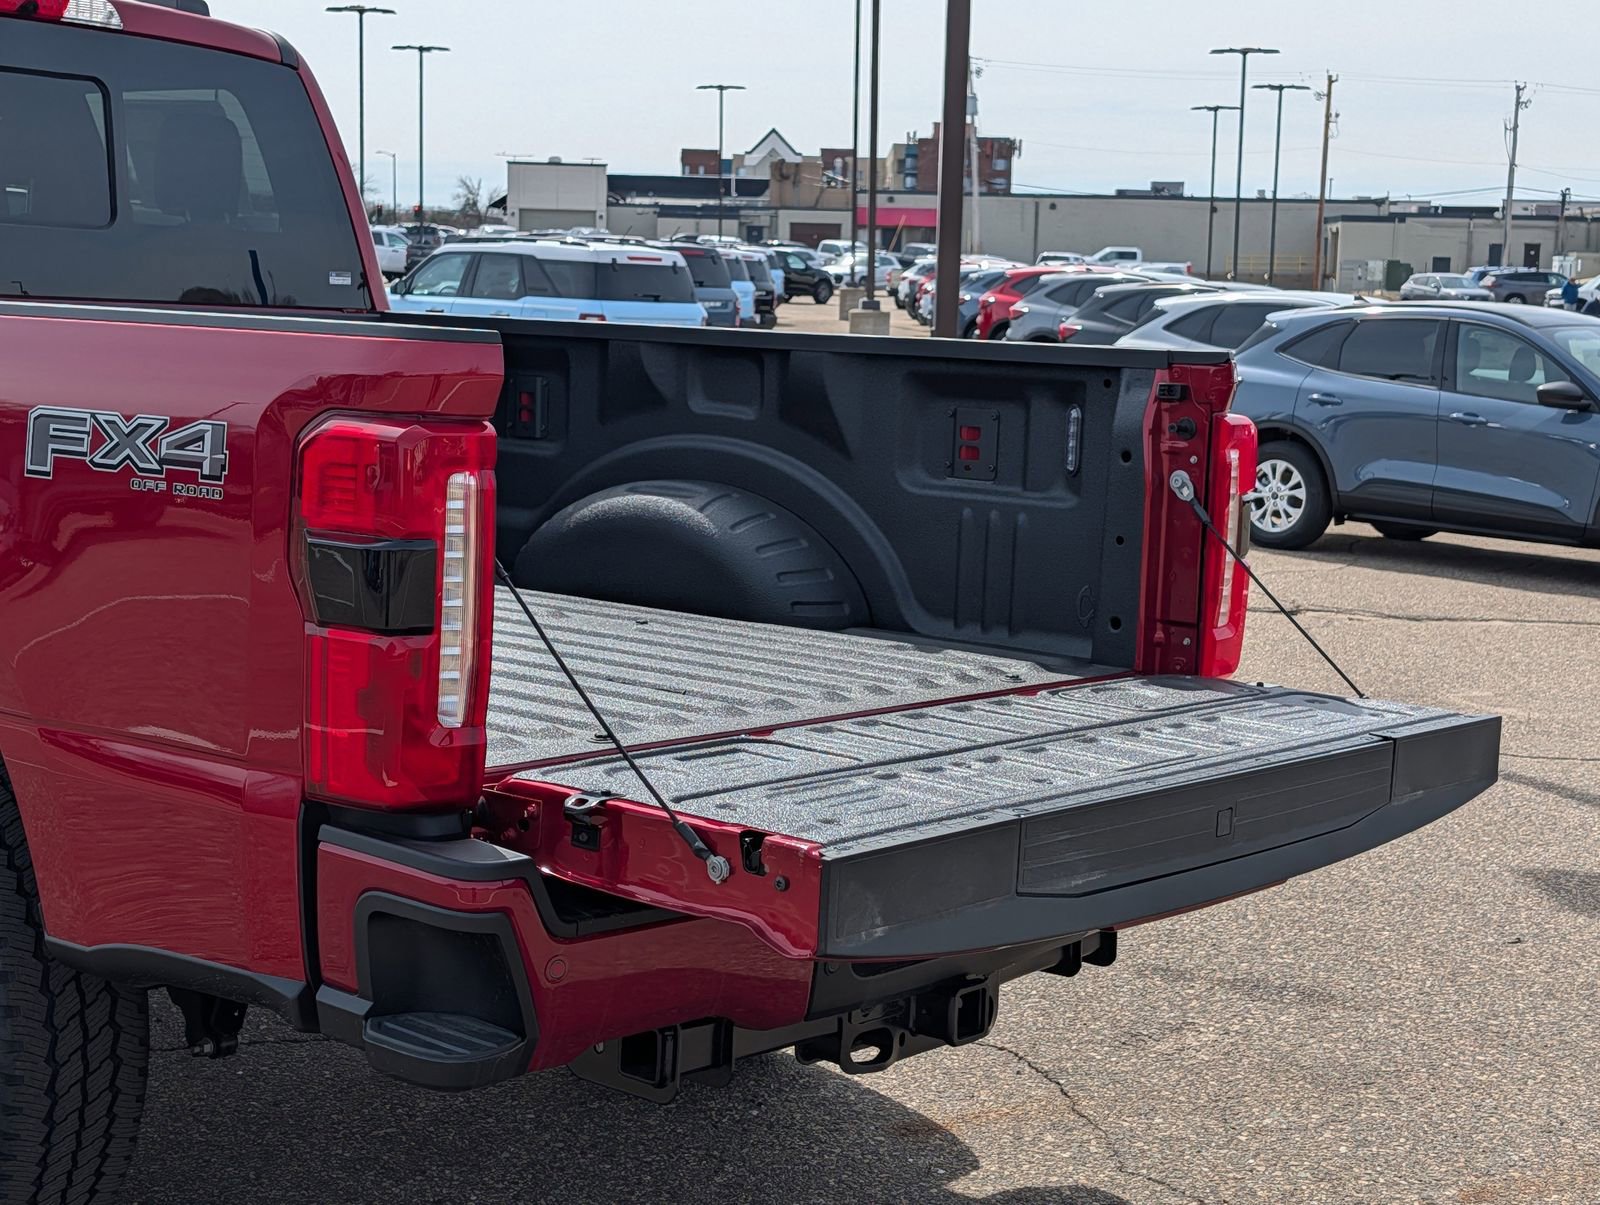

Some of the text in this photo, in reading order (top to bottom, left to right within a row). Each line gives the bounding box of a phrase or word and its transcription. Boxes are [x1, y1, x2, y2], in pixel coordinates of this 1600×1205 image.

[25, 405, 228, 484] FX4
[131, 478, 224, 499] OFF ROAD
